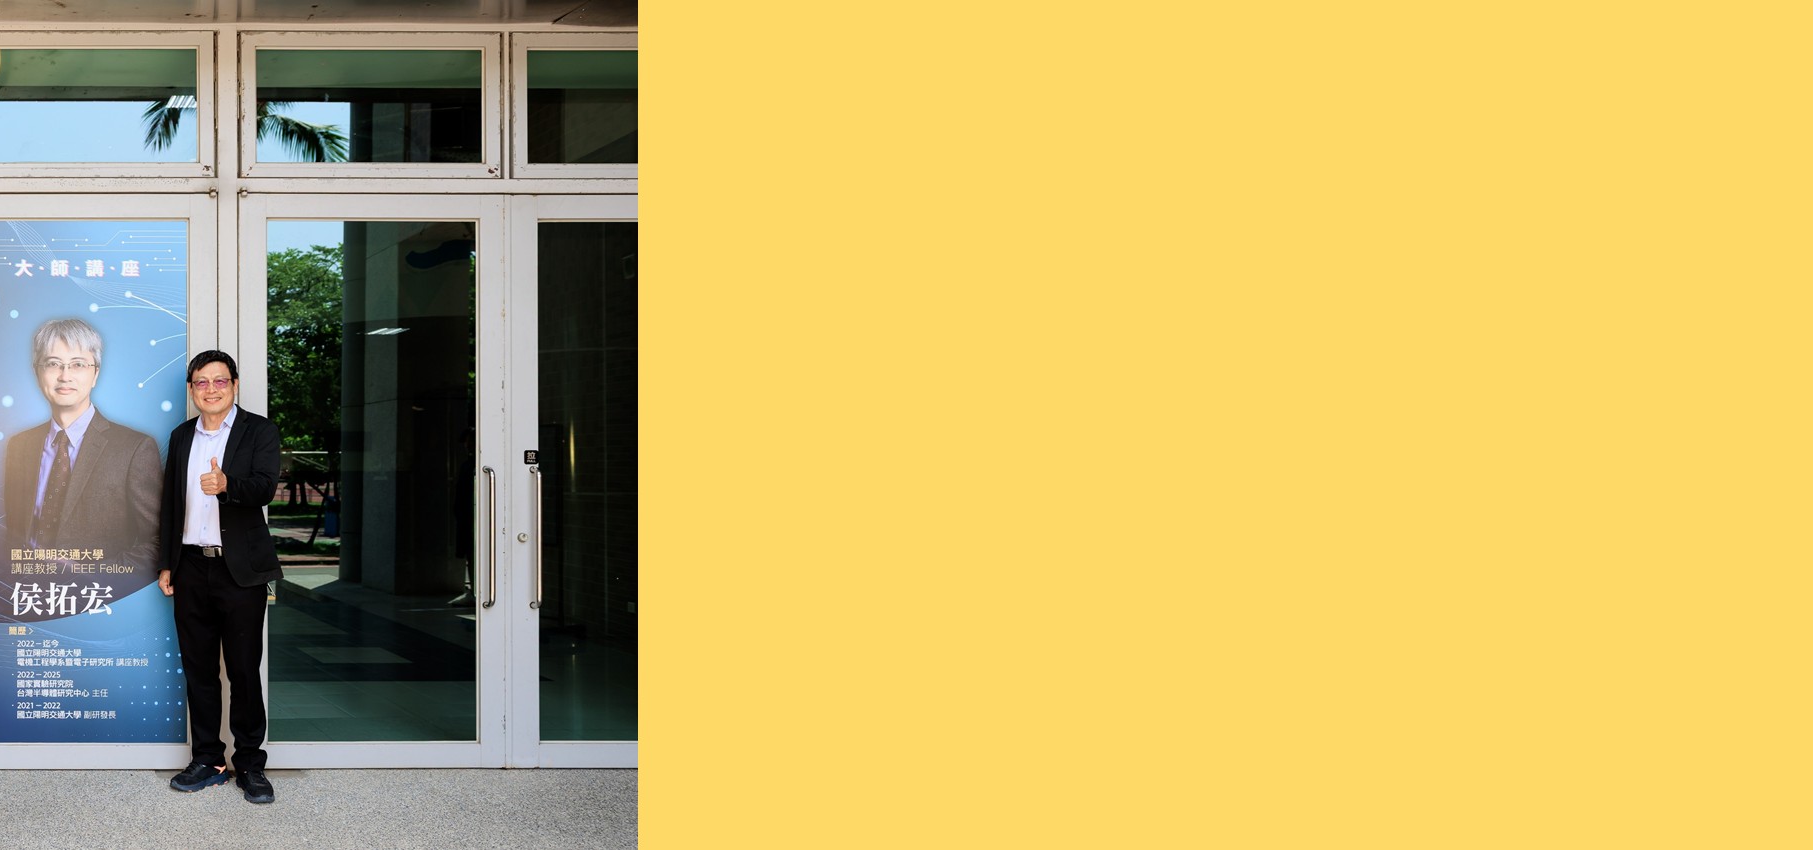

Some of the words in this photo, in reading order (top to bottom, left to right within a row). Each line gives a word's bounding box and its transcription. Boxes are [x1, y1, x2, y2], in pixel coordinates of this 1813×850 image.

[11, 549, 104, 560] 國立陽明交通大學
[11, 563, 58, 574] 講座教授
[71, 564, 96, 574] IEEE
[100, 564, 134, 574] Fellow
[10, 582, 113, 616] 侯拓宏
[16, 649, 82, 658] 國立陽明交通大學
[116, 658, 148, 666] 講座教授
[16, 680, 74, 688] 國家實驗研究院
[92, 689, 108, 698] 主任
[16, 711, 82, 719] 國立陽明交通大學
